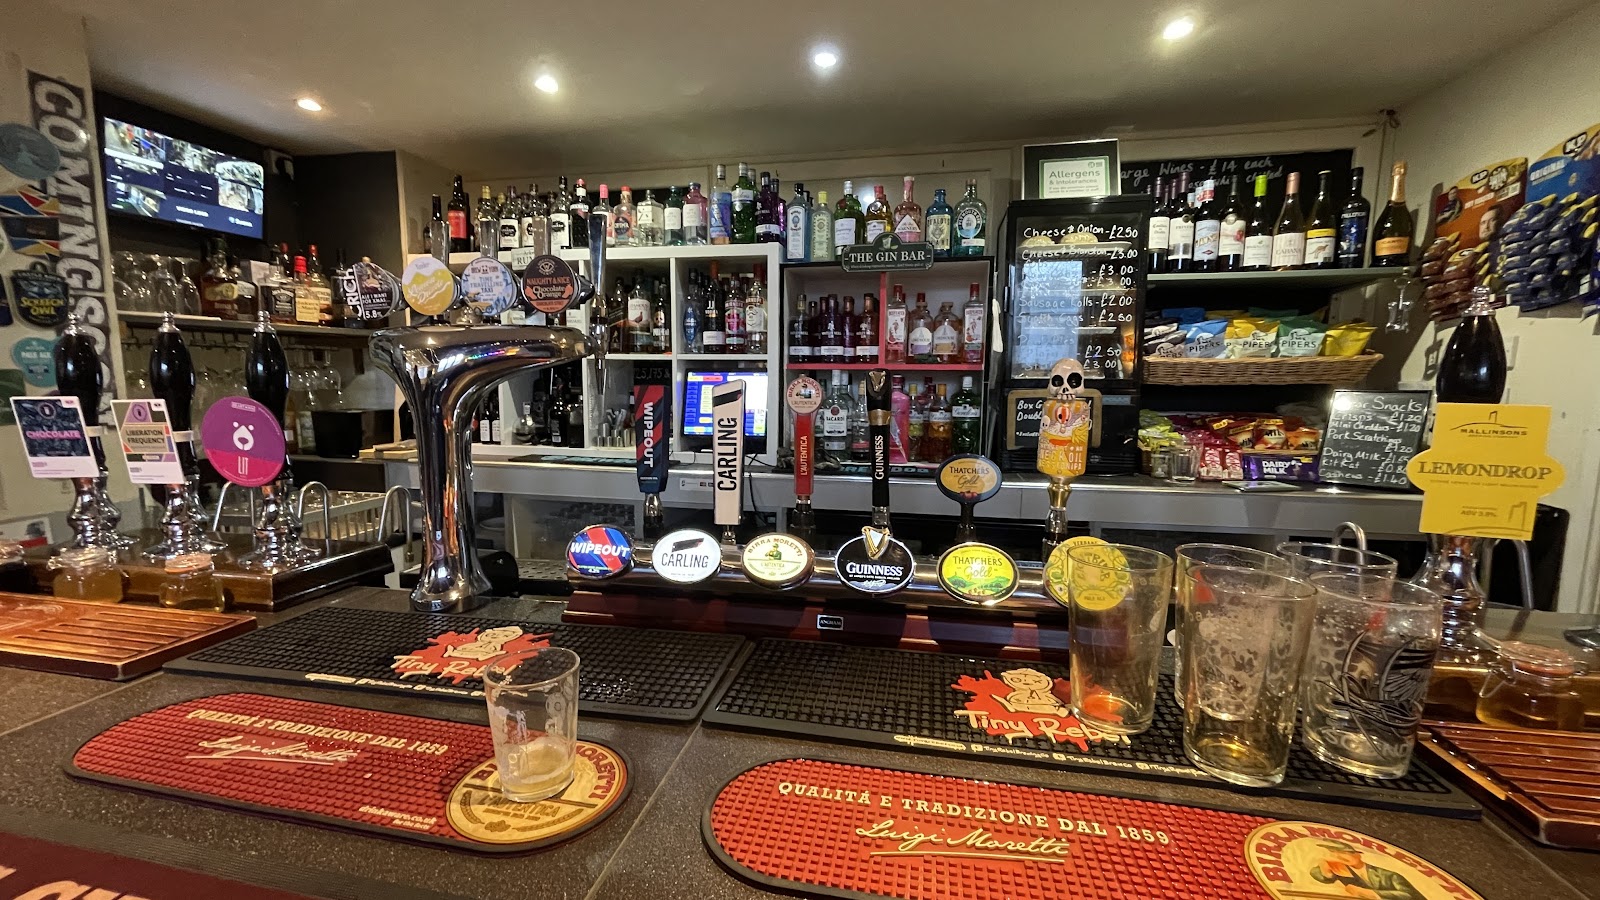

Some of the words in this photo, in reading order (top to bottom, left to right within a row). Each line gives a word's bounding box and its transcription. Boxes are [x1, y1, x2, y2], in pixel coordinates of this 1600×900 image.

[1565, 134, 1587, 152] KP
[1049, 170, 1101, 179] Allergens
[1120, 169, 1149, 187] arge
[1160, 162, 1194, 176] Wines
[1244, 156, 1273, 171] each
[1024, 227, 1066, 238] Cheese
[1077, 224, 1104, 234] Onion
[849, 252, 873, 263] THE
[876, 251, 898, 262] GIN
[901, 250, 925, 260] BAR
[1022, 249, 1060, 260] Cheese
[533, 285, 566, 293] Chocolate
[31, 306, 56, 316] OWL
[1019, 298, 1065, 311] Sausage
[1189, 341, 1220, 352] PIPERS
[1017, 400, 1034, 410] Box
[1372, 396, 1423, 412] Snacks
[26, 429, 82, 440] CHOCOLATE
[125, 429, 163, 437] LIBERATION
[643, 402, 654, 468] WIPEOUT
[1327, 428, 1350, 440] Pork
[1460, 428, 1528, 436] MALLINSONS
[127, 436, 165, 445] FREQUENCY
[717, 417, 737, 491] CARLING
[874, 434, 885, 480] GUINNESS
[1068, 452, 1083, 463] OIL
[1354, 451, 1380, 460] Milk
[949, 466, 990, 476] THATCHERS
[1262, 460, 1291, 469] DAIRY
[1263, 467, 1287, 475] MILK
[1418, 461, 1553, 481] LEMONDROP
[957, 475, 979, 487] Gold
[570, 540, 630, 558] WIPEOUT
[747, 538, 772, 554] BIRRA
[773, 537, 803, 558] MORETTI
[661, 552, 710, 568] CARLING
[952, 555, 1003, 567] THATCHERS
[845, 562, 905, 577] GUINNESS
[963, 566, 993, 581] Gold
[390, 655, 439, 680] Tiny
[954, 709, 1034, 744] Tiny
[255, 717, 269, 728] E
[267, 719, 371, 744] TRADIZIONE
[368, 733, 409, 750] DAL
[407, 740, 449, 756] 1859
[778, 780, 873, 806] QUALITÁ
[879, 795, 895, 809] E
[900, 798, 1050, 830] TRADIZIONE
[1057, 817, 1109, 838] DAL
[1114, 826, 1171, 846] 1859
[855, 818, 946, 853] Luigi
[943, 826, 1072, 856] Moretti
[1254, 825, 1307, 884] BIRRA
